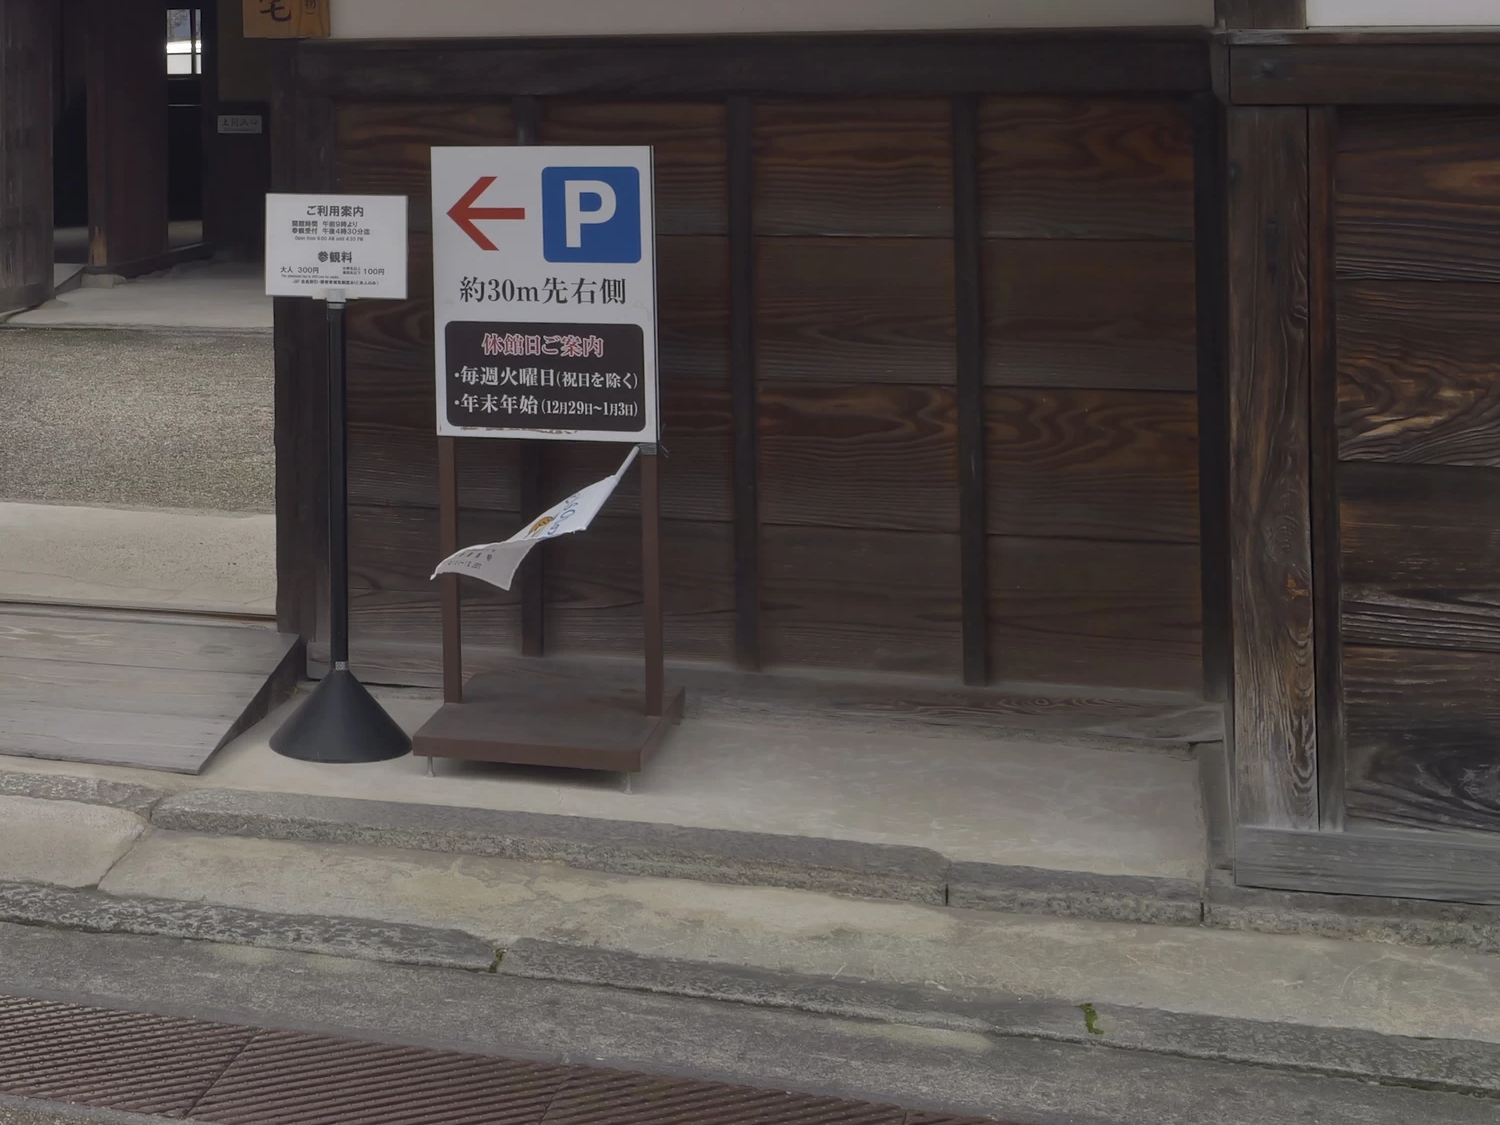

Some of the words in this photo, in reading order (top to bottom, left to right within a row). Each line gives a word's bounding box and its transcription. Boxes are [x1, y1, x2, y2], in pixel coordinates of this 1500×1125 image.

[306, 205, 364, 218] ご利用案内
[564, 180, 617, 248] P
[291, 220, 318, 228] 開館時間
[322, 228, 371, 236] 午後4時30分迄
[317, 251, 353, 263] 参観料
[280, 266, 293, 274] 大人
[297, 266, 319, 274] 300円
[460, 276, 626, 305] 約30m先右側
[482, 333, 604, 358] 休館日ご案内
